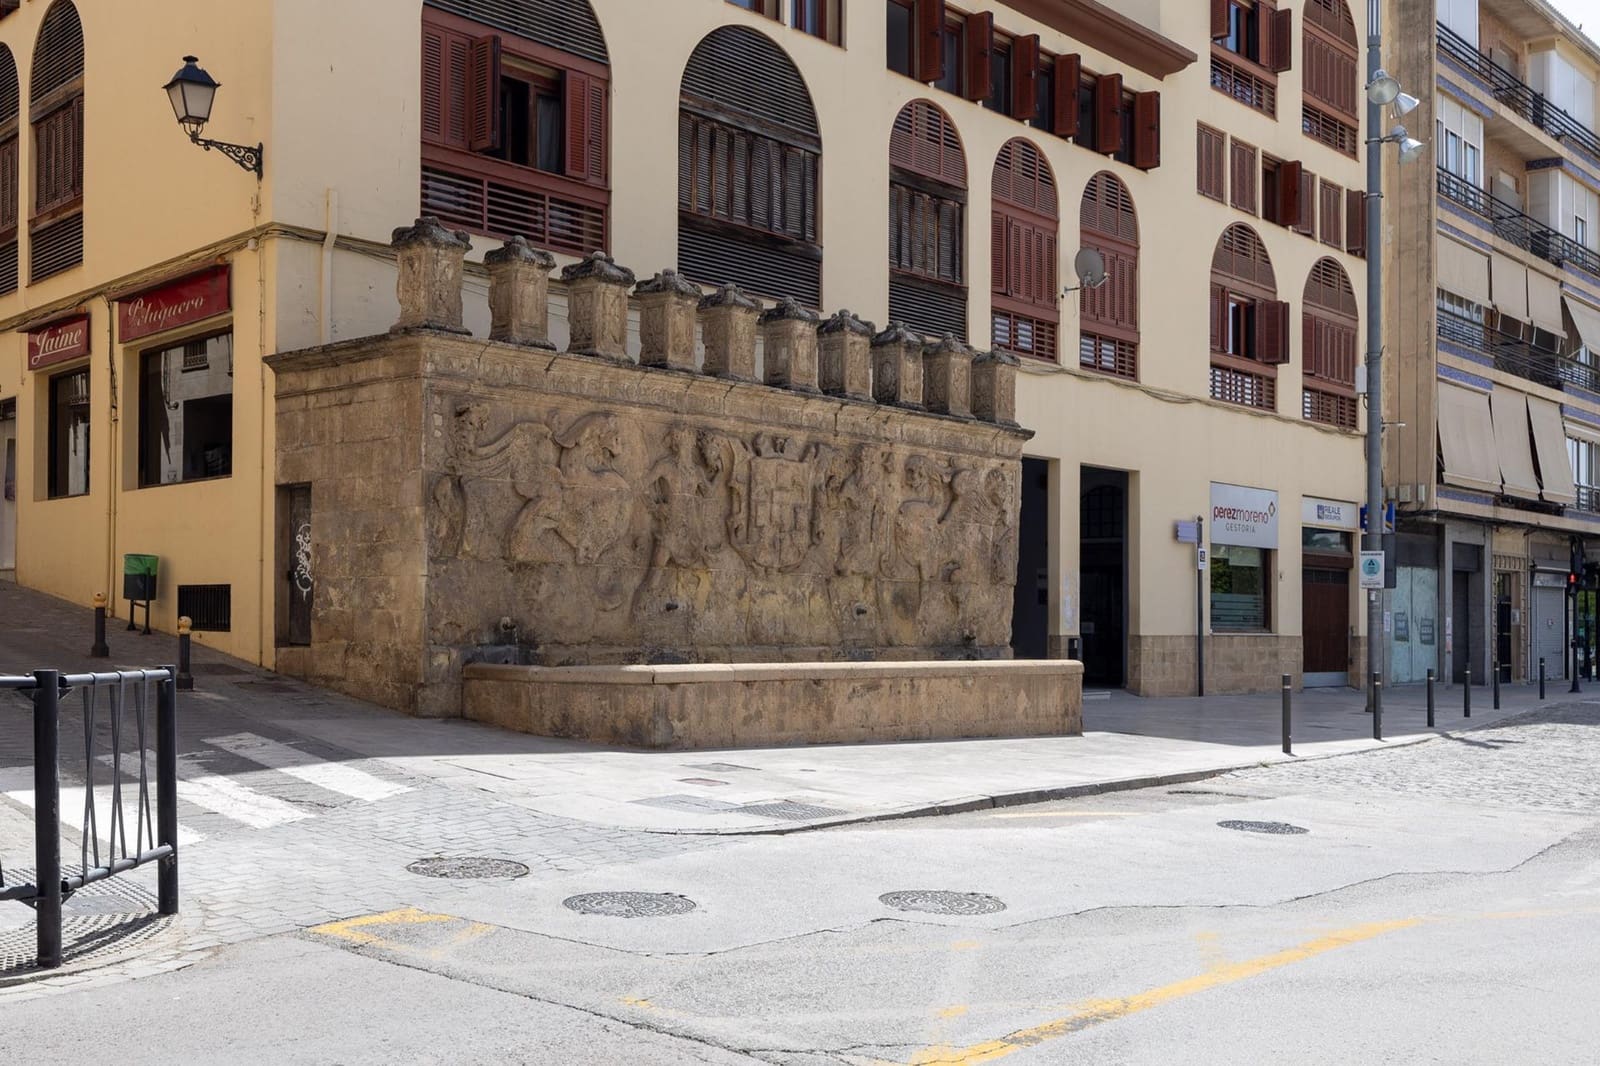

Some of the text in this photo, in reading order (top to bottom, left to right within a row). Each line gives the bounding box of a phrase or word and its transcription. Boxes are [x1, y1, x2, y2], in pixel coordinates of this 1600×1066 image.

[31, 326, 82, 365] Jaime
[1213, 505, 1269, 524] perezmoreno
[1225, 522, 1256, 534] GESTORIA
